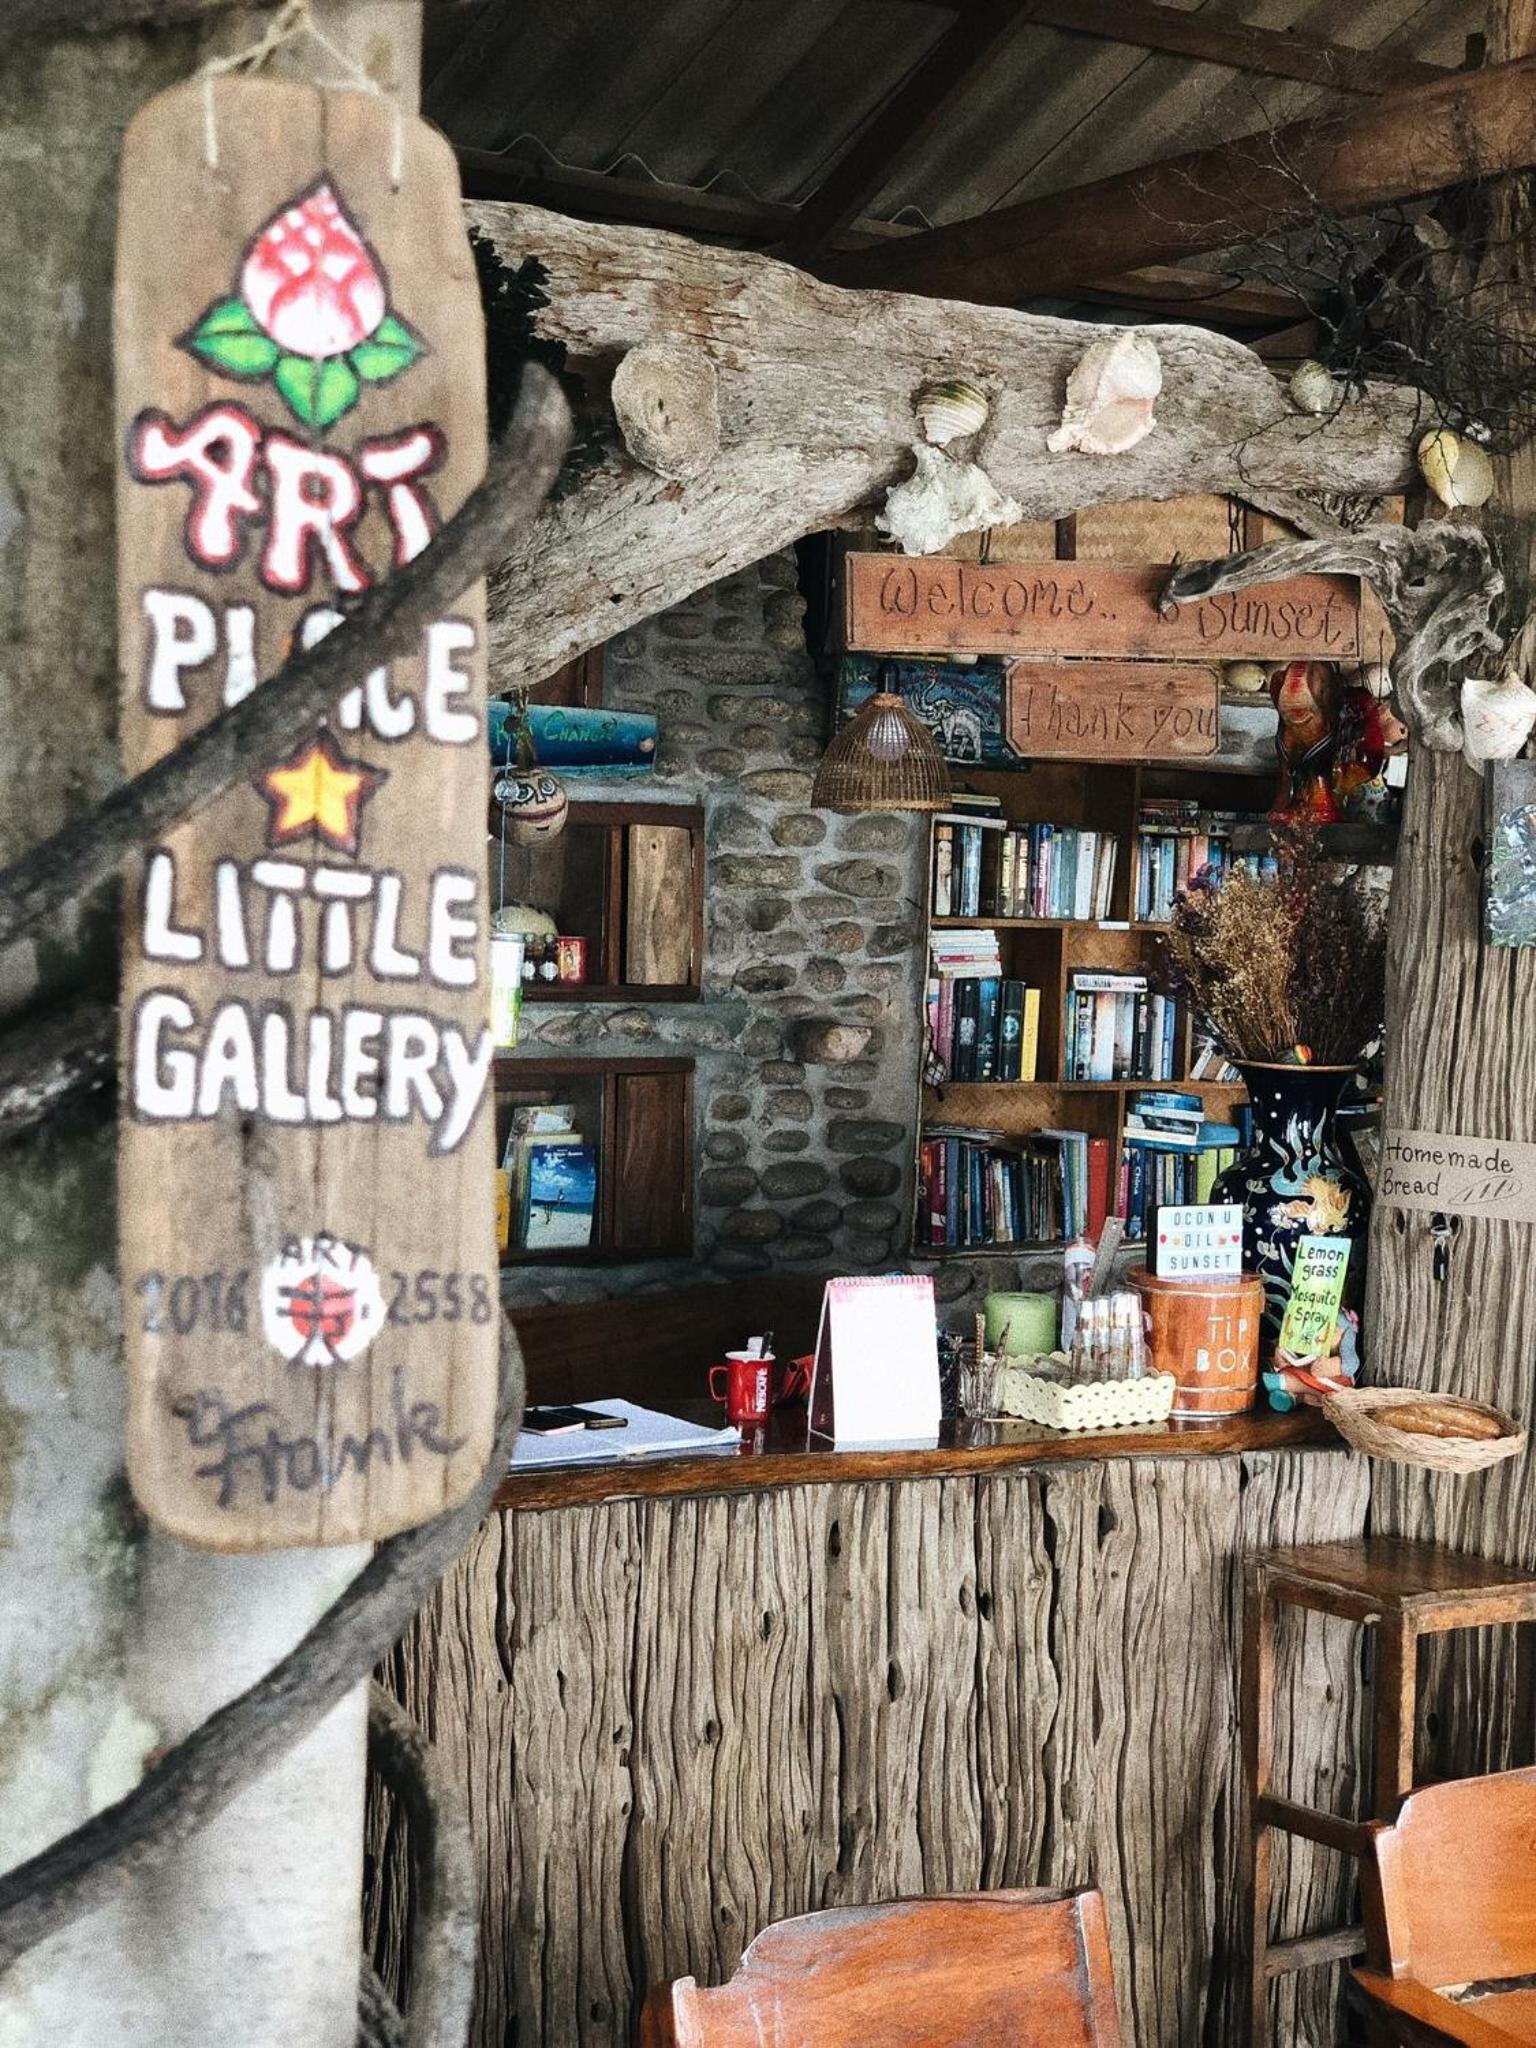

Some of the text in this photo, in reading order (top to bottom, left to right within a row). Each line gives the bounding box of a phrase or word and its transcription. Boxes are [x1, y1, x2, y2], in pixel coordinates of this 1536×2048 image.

[134, 404, 438, 596] ART
[1021, 683, 1215, 750] Thank you
[143, 852, 478, 986] LITTLE
[134, 992, 496, 1152] GALLERY
[1385, 1136, 1514, 1174] Homemade
[1381, 1167, 1442, 1197] Bread
[279, 1229, 375, 1272] ART
[1184, 1234, 1213, 1248] OIL
[1298, 1241, 1345, 1262] Lemon
[1170, 1254, 1232, 1270] SUNSET
[1302, 1264, 1339, 1281] grass
[1291, 1283, 1337, 1309] Mosquito
[1294, 1307, 1329, 1331] Spray
[1196, 1348, 1250, 1373] BOX
